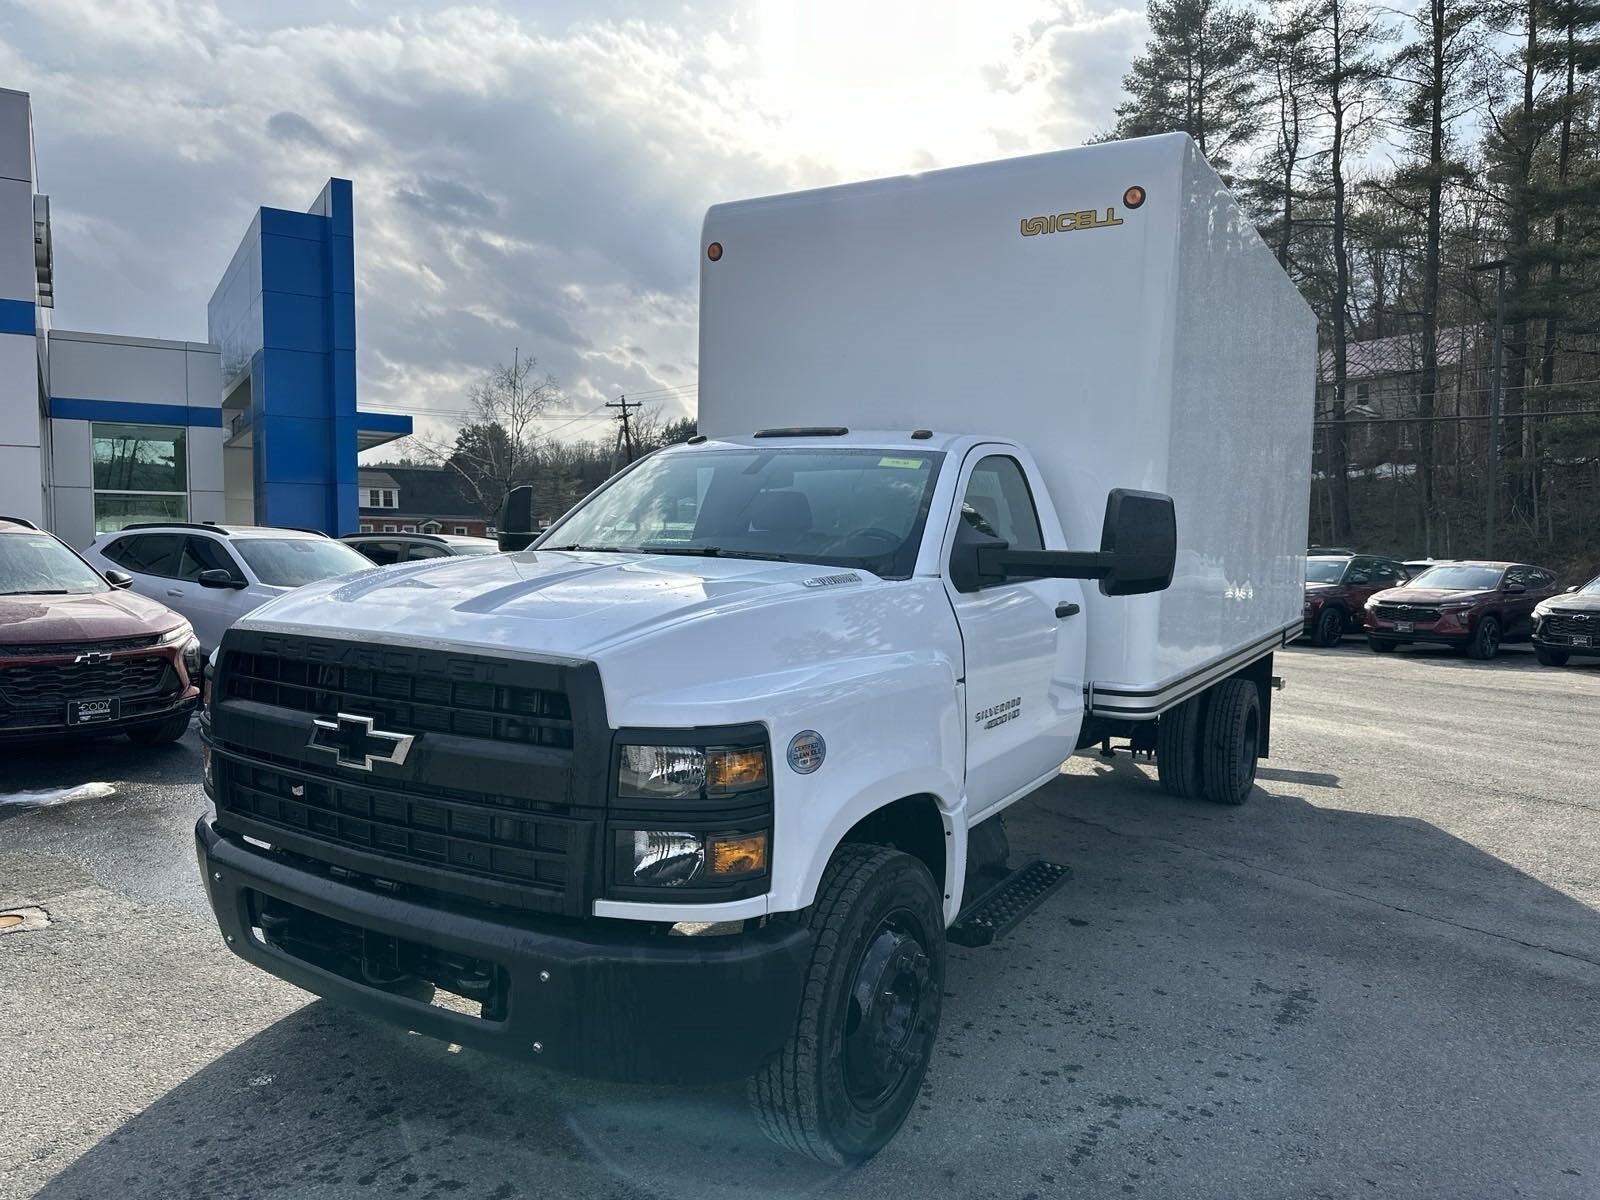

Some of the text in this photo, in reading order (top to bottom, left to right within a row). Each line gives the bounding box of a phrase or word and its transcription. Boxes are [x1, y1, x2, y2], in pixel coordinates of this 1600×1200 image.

[261, 636, 509, 682] CHEVROLET
[79, 699, 111, 711] CODY
[975, 696, 1021, 722] SILVERADO
